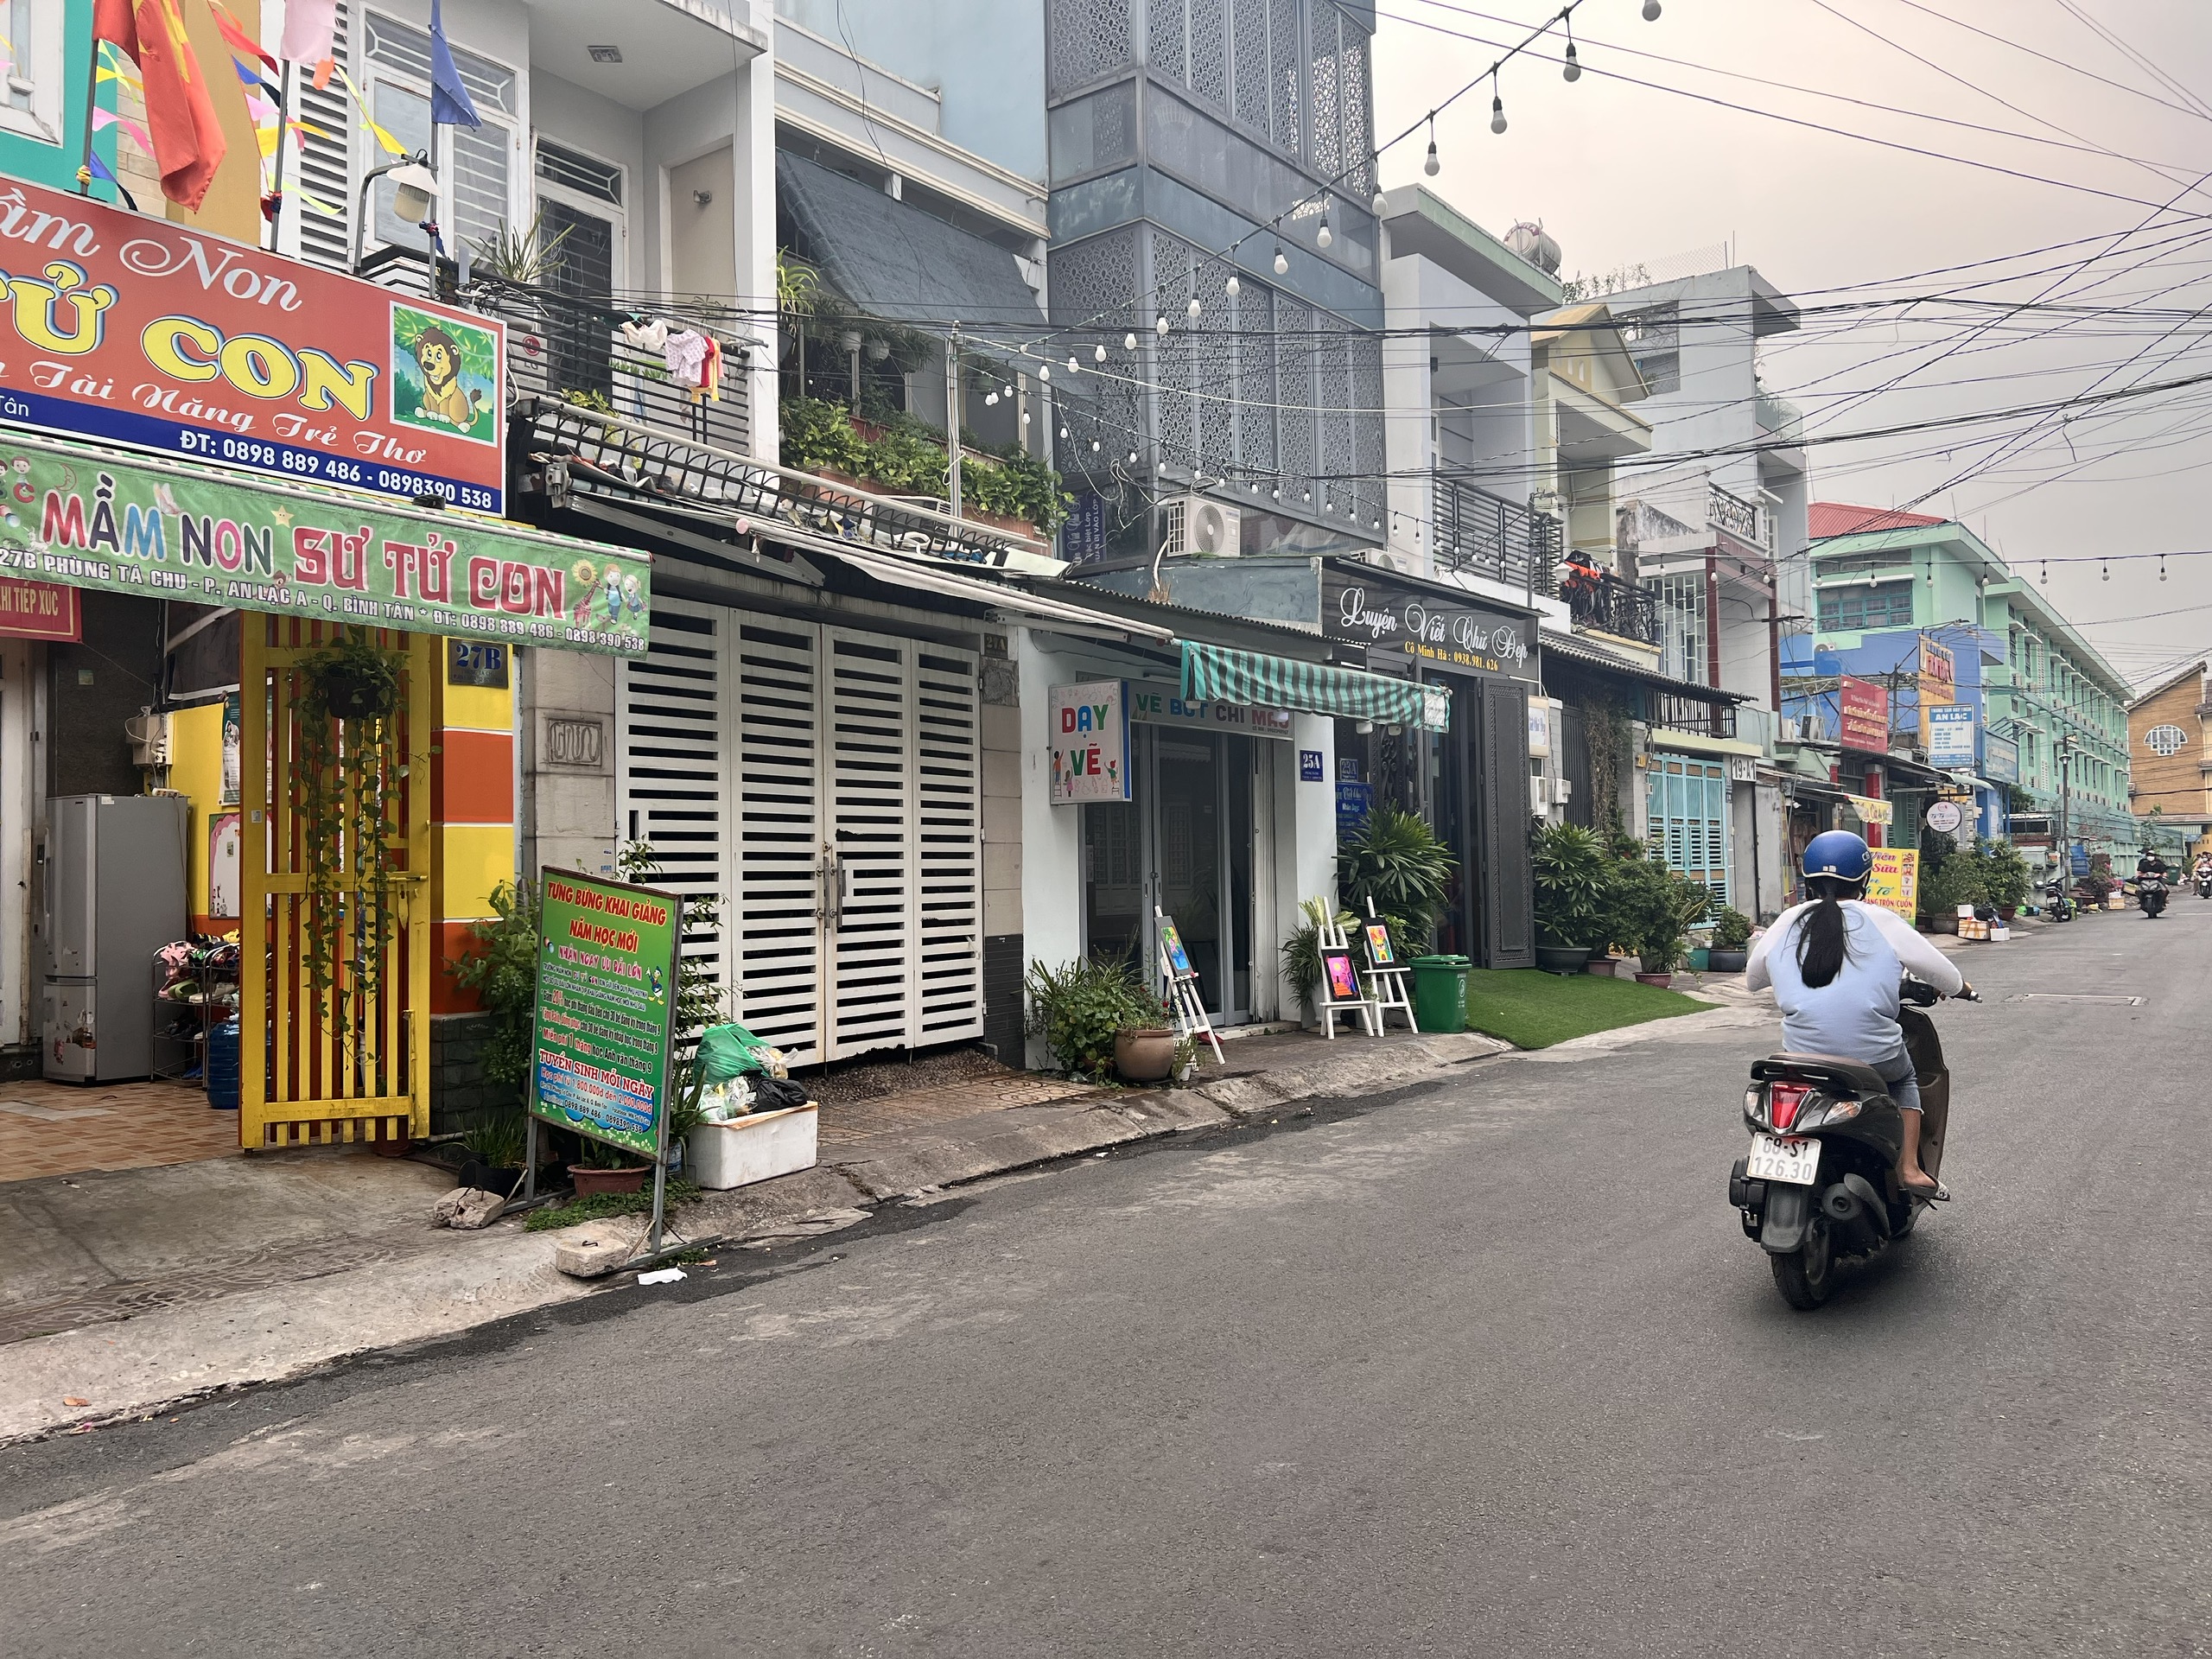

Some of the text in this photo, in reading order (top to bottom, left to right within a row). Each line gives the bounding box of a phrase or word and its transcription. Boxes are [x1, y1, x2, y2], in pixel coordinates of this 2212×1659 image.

[119, 237, 302, 312] Non
[0, 259, 380, 422] Ử CON
[29, 360, 116, 400] Tài
[131, 383, 257, 432] Năng
[272, 412, 339, 447] Trẻ
[353, 430, 428, 464] Thơ
[180, 429, 216, 454] ĐT:
[223, 438, 275, 466] 0898
[282, 450, 319, 474] 889
[326, 459, 361, 482] 486
[378, 470, 455, 501] 0898390
[461, 487, 493, 508] 538
[42, 471, 567, 621] MẦM NON SƯ TỬ CON
[0, 581, 59, 616] HI TIẾP XÚC
[0, 548, 37, 569] 27B
[43, 554, 111, 581] PHÙNG
[117, 564, 143, 585] TÁ
[150, 569, 187, 590] CHU
[204, 576, 222, 596] P.
[228, 581, 254, 601] AN
[257, 584, 291, 605] LẠC
[296, 590, 309, 607] A
[322, 594, 339, 613] Q.
[344, 594, 379, 617] BÌNH
[383, 601, 415, 621] TÂN
[433, 609, 457, 627] ĐT:
[461, 613, 496, 632] 0898
[500, 619, 524, 636] 889
[530, 623, 554, 639] 486
[565, 627, 596, 645] 0898
[600, 632, 621, 648] 390
[624, 635, 645, 652] 538
[1340, 588, 1528, 669] Luyện Viết Chữ Đẹp
[455, 643, 502, 671] 27B
[1405, 641, 1415, 654] Cô
[1417, 643, 1434, 658] Minh
[1135, 692, 1162, 714] VẼ
[1061, 704, 1109, 739] DẠY
[1071, 743, 1102, 776] VẼ
[1303, 753, 1320, 769] 25A
[1872, 863, 1898, 874] Sữa
[575, 887, 602, 911] BỪNG
[605, 896, 631, 918] KHAI
[632, 899, 666, 926] GIẢNG
[569, 917, 639, 953] NĂM HỌC MỚI
[580, 950, 600, 969] NGAY
[539, 1048, 573, 1071] TUYỂN
[574, 1061, 599, 1081] SINH
[622, 1077, 654, 1100] NGÀY
[579, 1104, 590, 1115] 889
[591, 1109, 601, 1119] 486
[1755, 1157, 1812, 1181] 126.30
